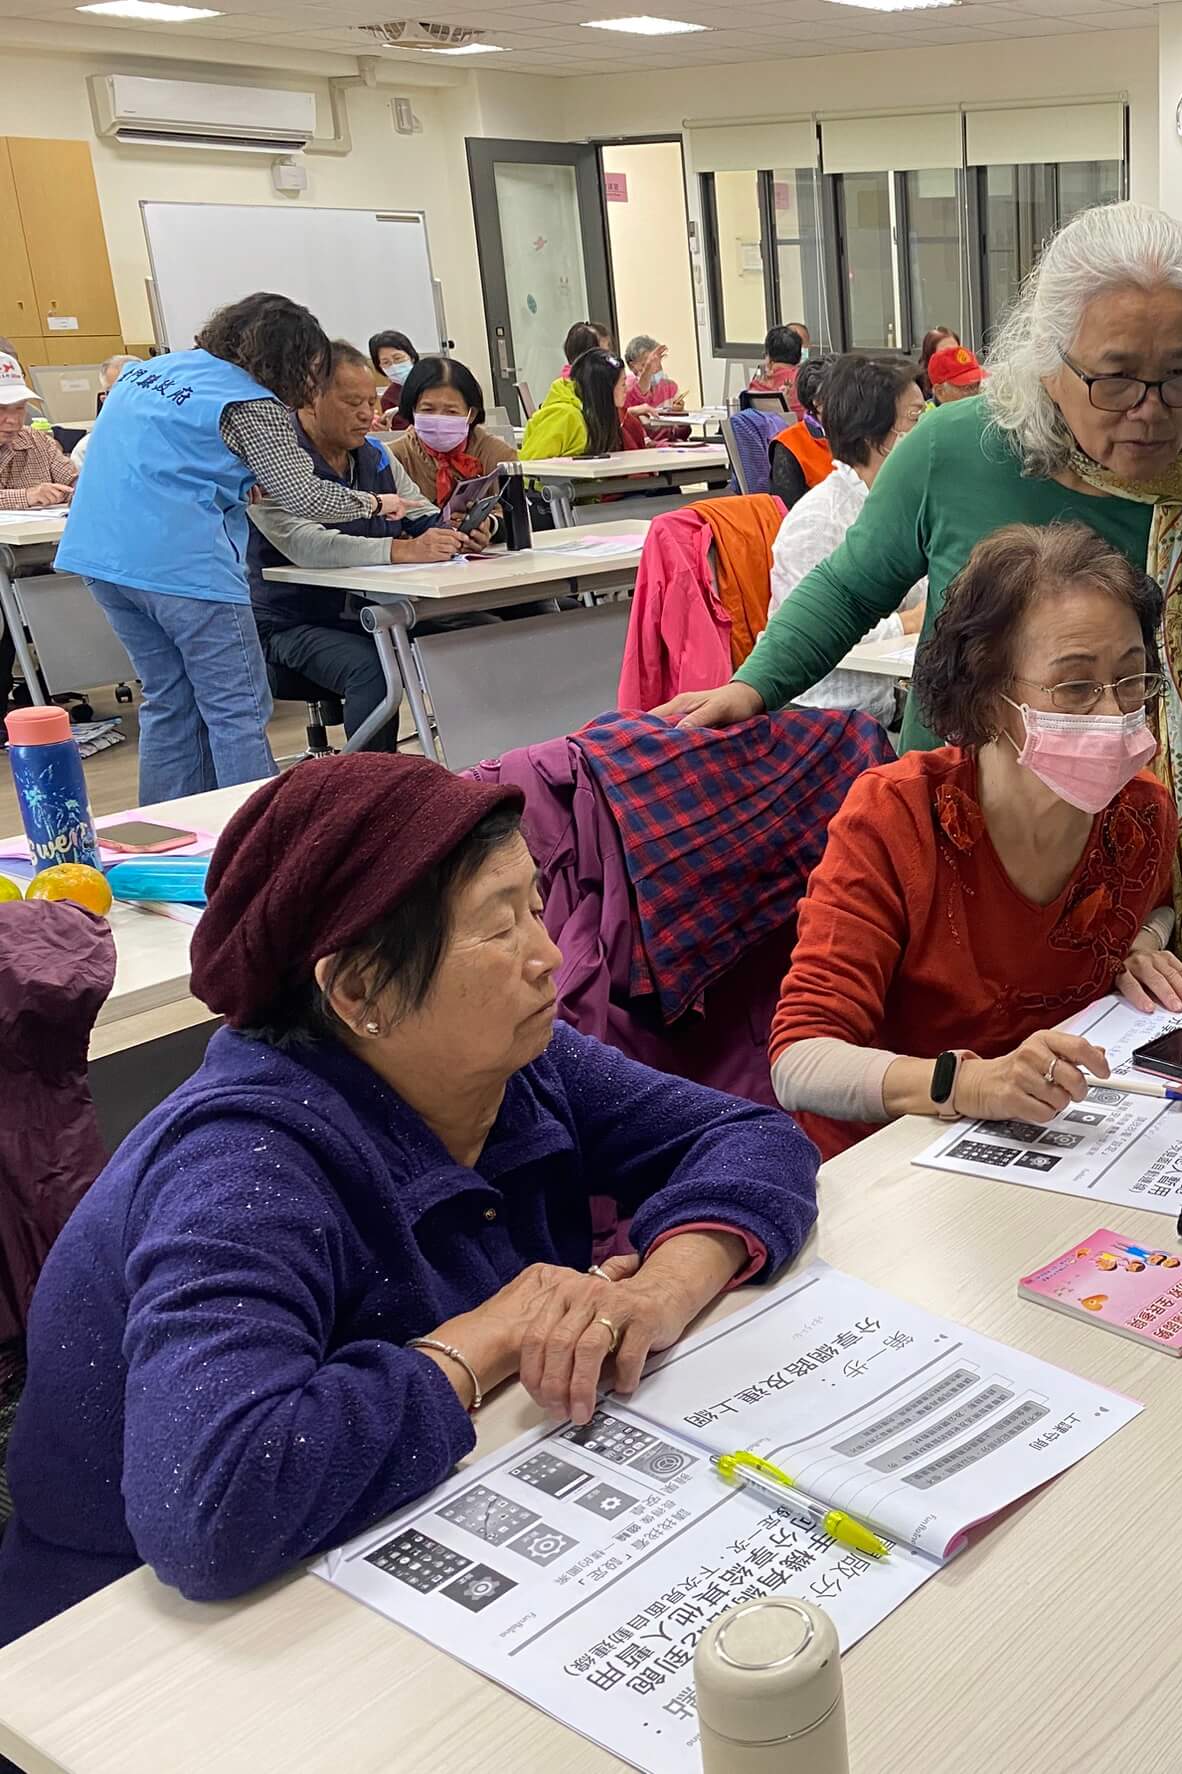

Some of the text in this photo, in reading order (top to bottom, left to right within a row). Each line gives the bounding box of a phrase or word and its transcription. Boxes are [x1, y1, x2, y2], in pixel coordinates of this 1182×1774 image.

[684, 1317, 880, 1428] 分享網路及連上網
[1029, 1413, 1080, 1450] 上課守則
[587, 1515, 817, 1691] 可分享給其他人暫用
